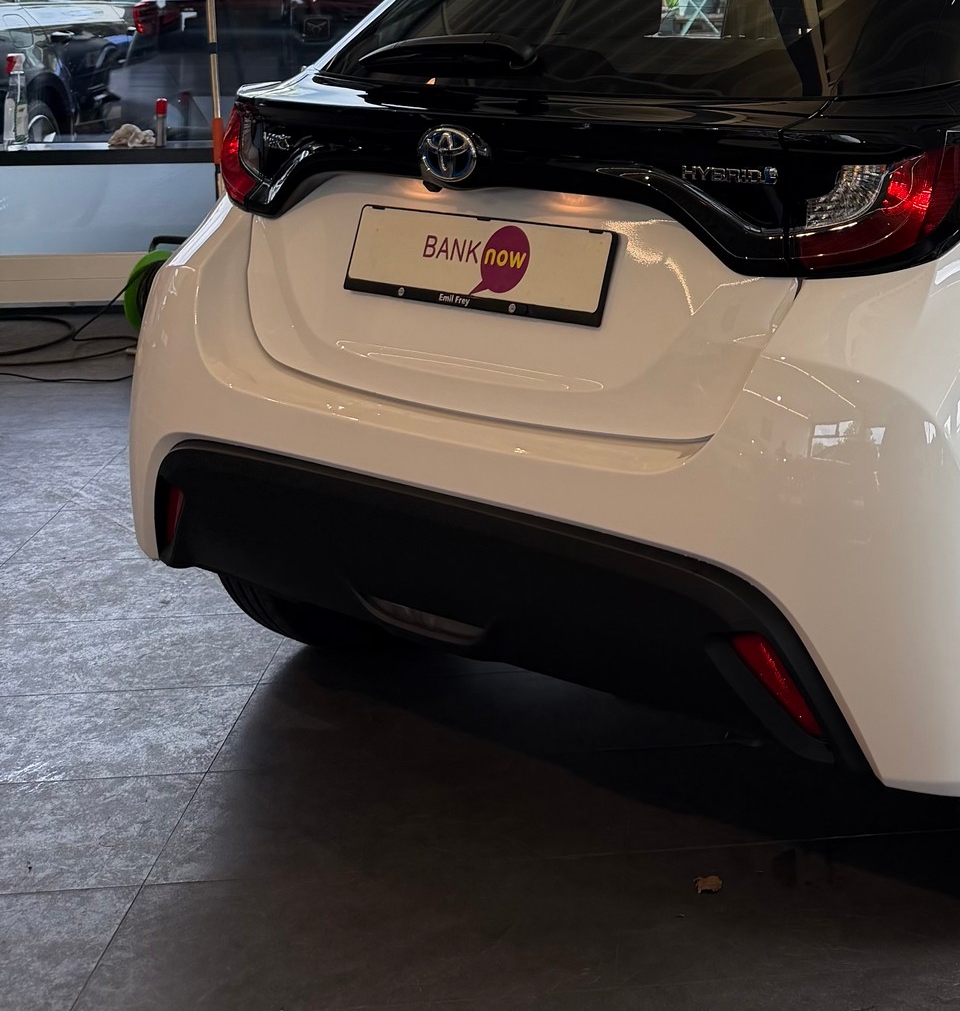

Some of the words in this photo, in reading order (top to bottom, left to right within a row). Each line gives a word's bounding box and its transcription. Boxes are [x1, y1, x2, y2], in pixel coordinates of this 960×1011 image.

[682, 165, 762, 183] HYBRID
[423, 235, 481, 264] BANK
[484, 248, 527, 269] now
[438, 293, 454, 303] Emil
[455, 295, 470, 307] Frey
